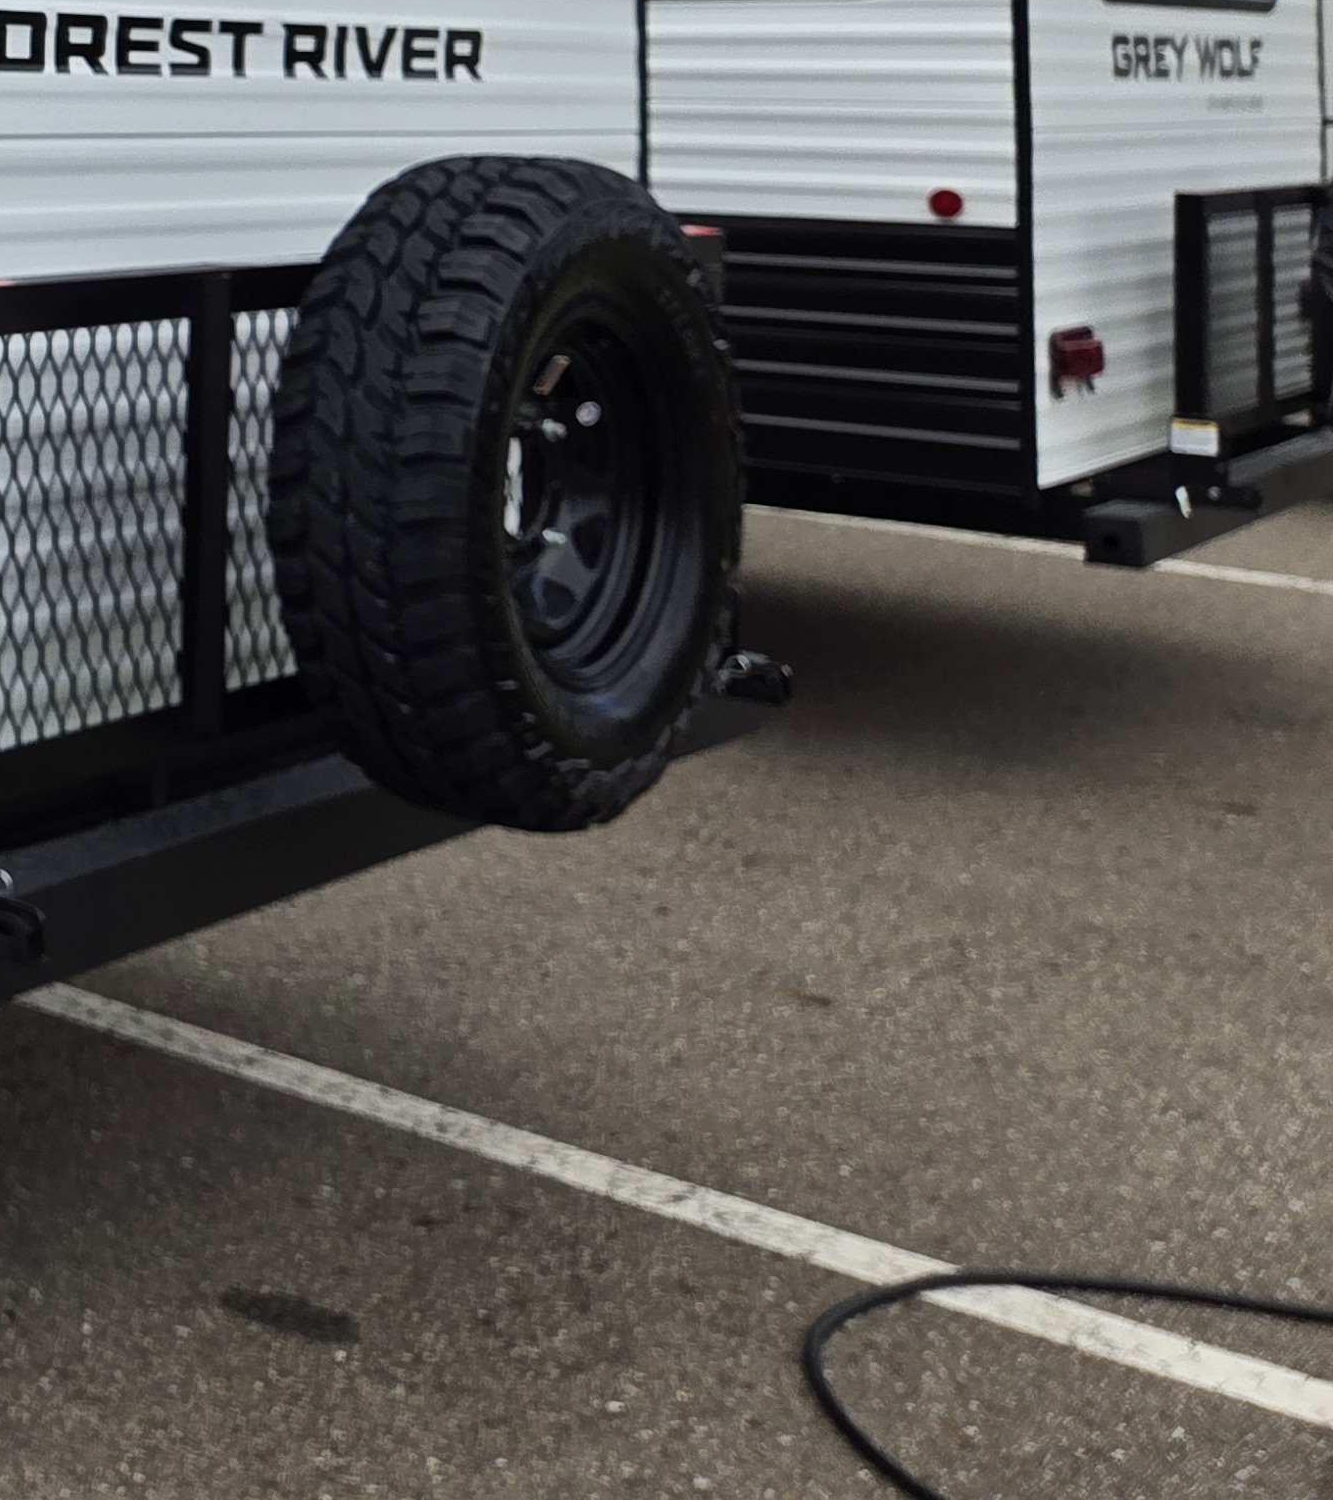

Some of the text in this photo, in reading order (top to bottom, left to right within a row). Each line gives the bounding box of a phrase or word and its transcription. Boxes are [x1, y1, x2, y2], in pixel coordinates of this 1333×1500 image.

[281, 21, 485, 83] RIVER
[1112, 32, 1262, 81] GREY WOLF
